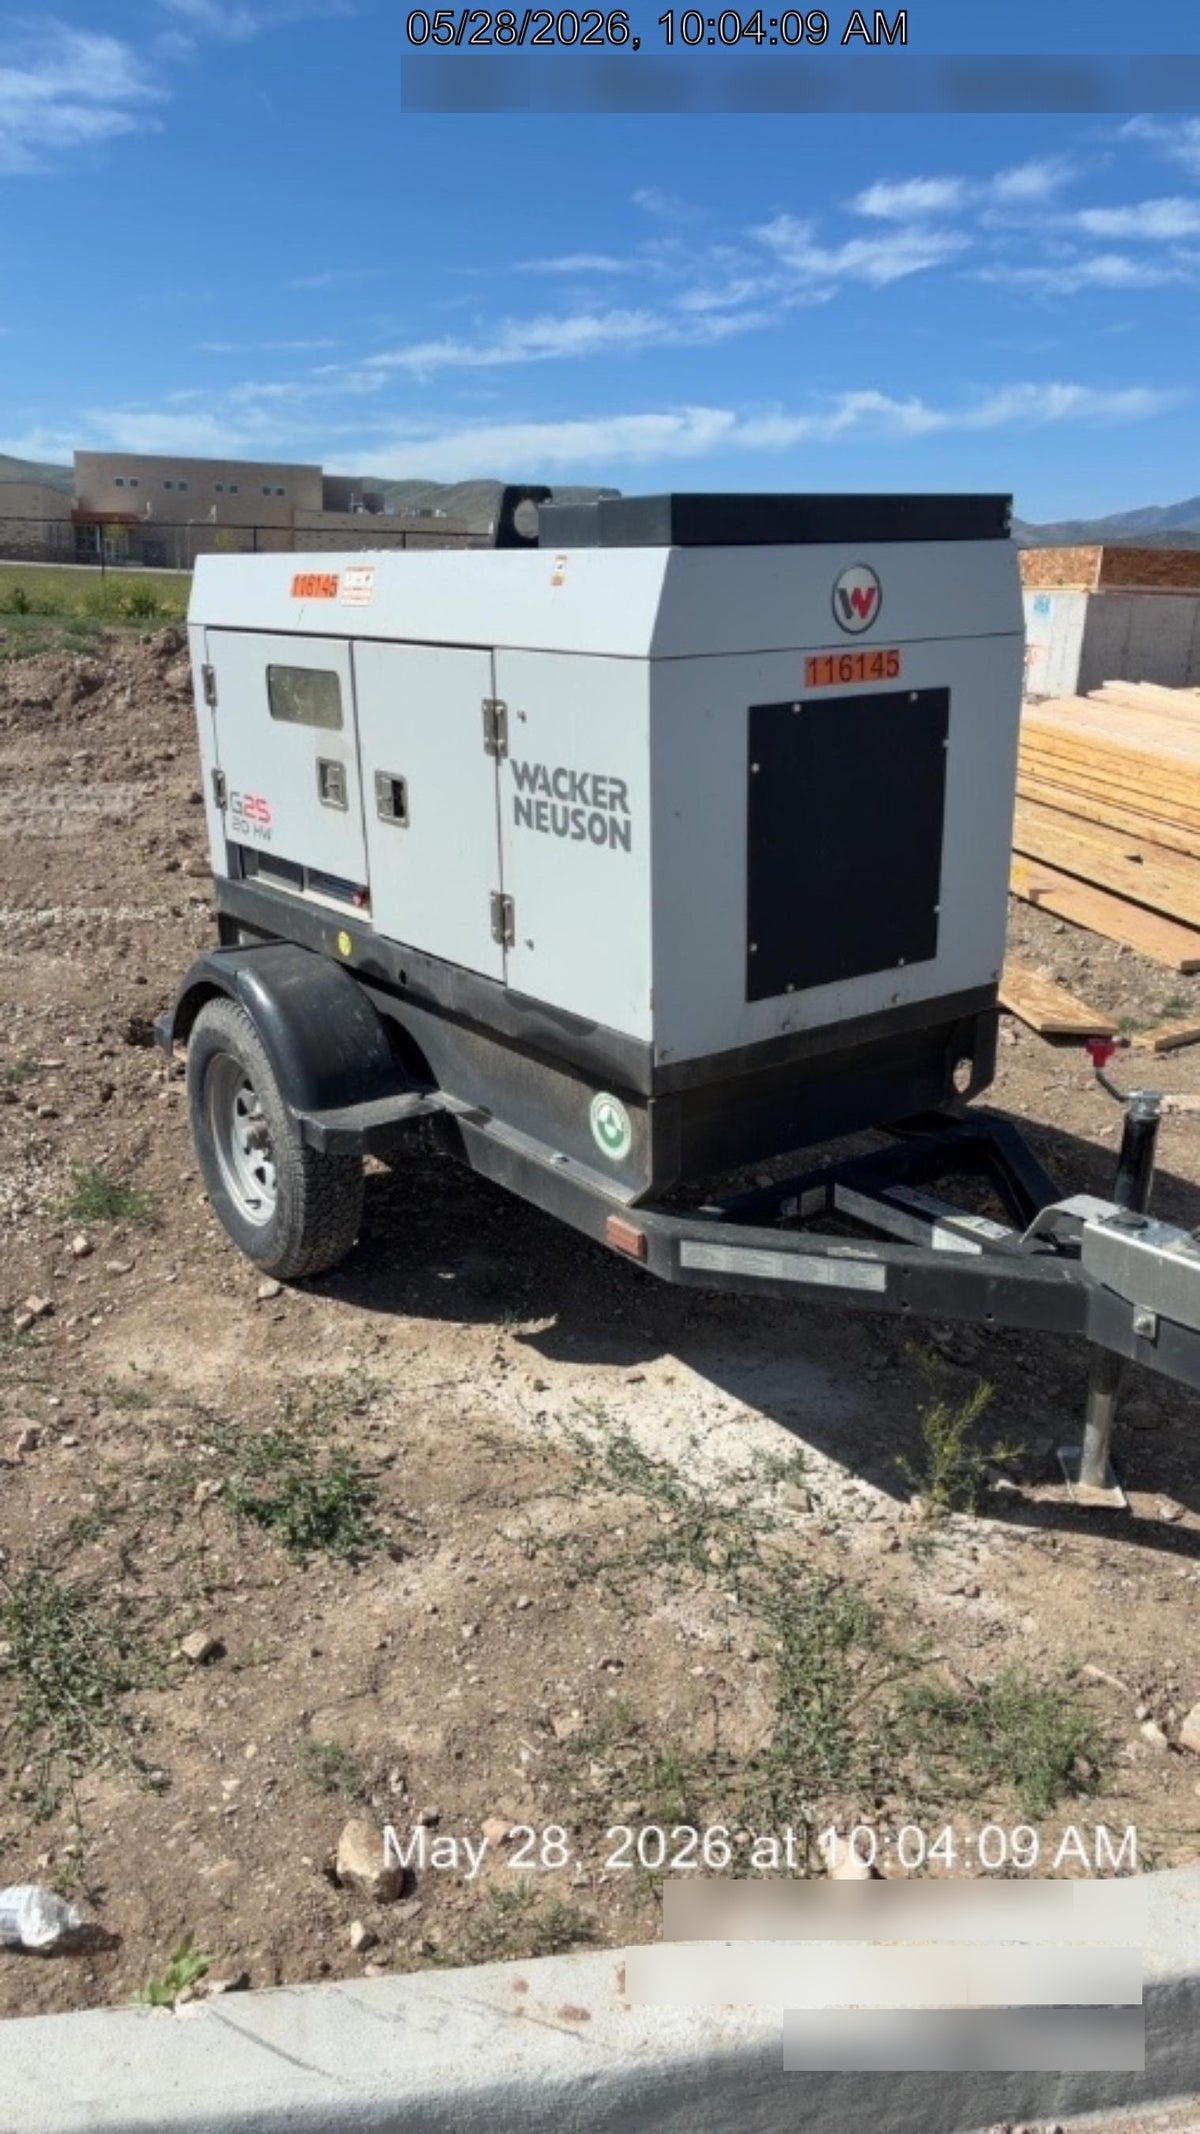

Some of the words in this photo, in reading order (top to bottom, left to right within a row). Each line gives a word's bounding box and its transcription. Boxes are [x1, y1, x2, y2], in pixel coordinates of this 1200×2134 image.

[291, 574, 339, 597] 116145
[806, 649, 900, 685] 116145
[509, 758, 631, 815] WACKER
[230, 791, 271, 823] G25
[514, 795, 632, 853] NEUSON
